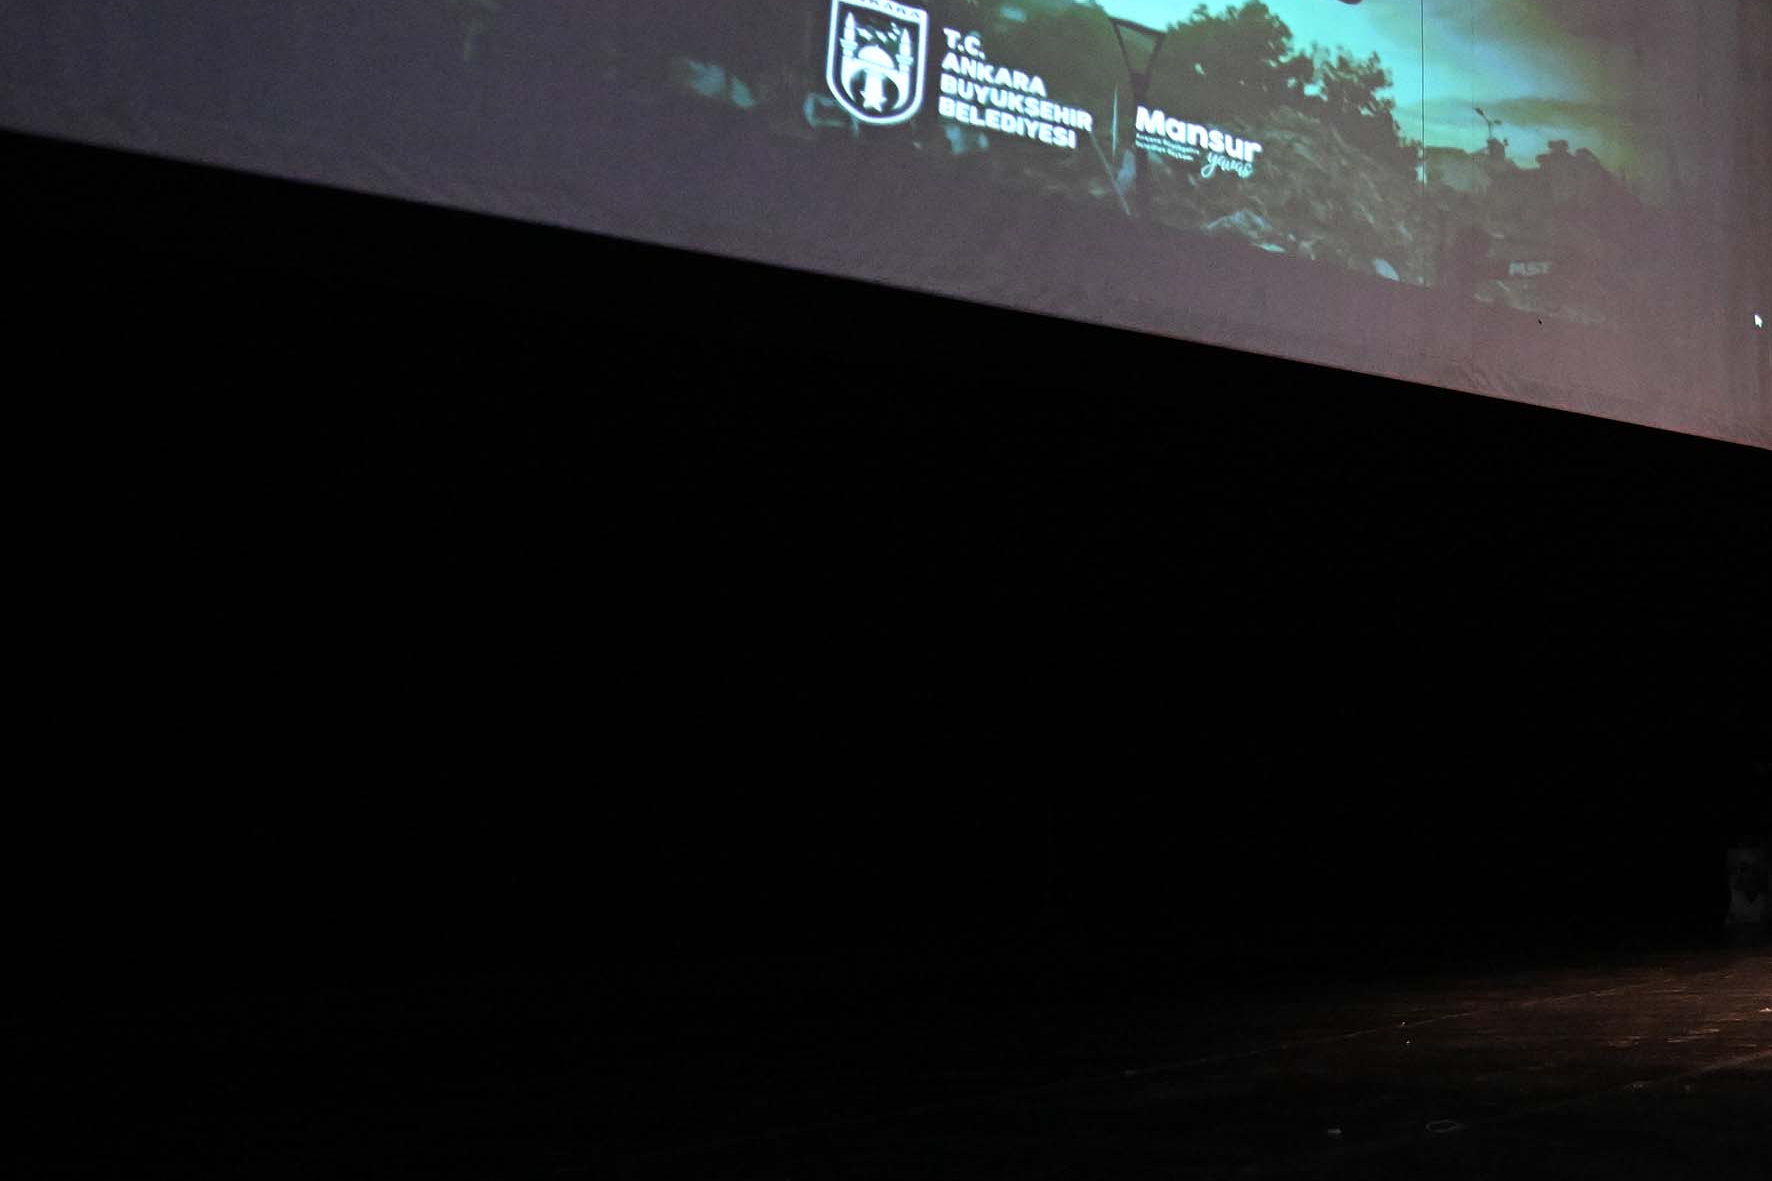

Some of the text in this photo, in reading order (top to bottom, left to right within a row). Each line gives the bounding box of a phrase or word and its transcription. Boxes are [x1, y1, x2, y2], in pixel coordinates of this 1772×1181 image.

[943, 27, 986, 60] T.C.
[941, 52, 1048, 98] ANKARA
[1135, 105, 1262, 163] Mansur
